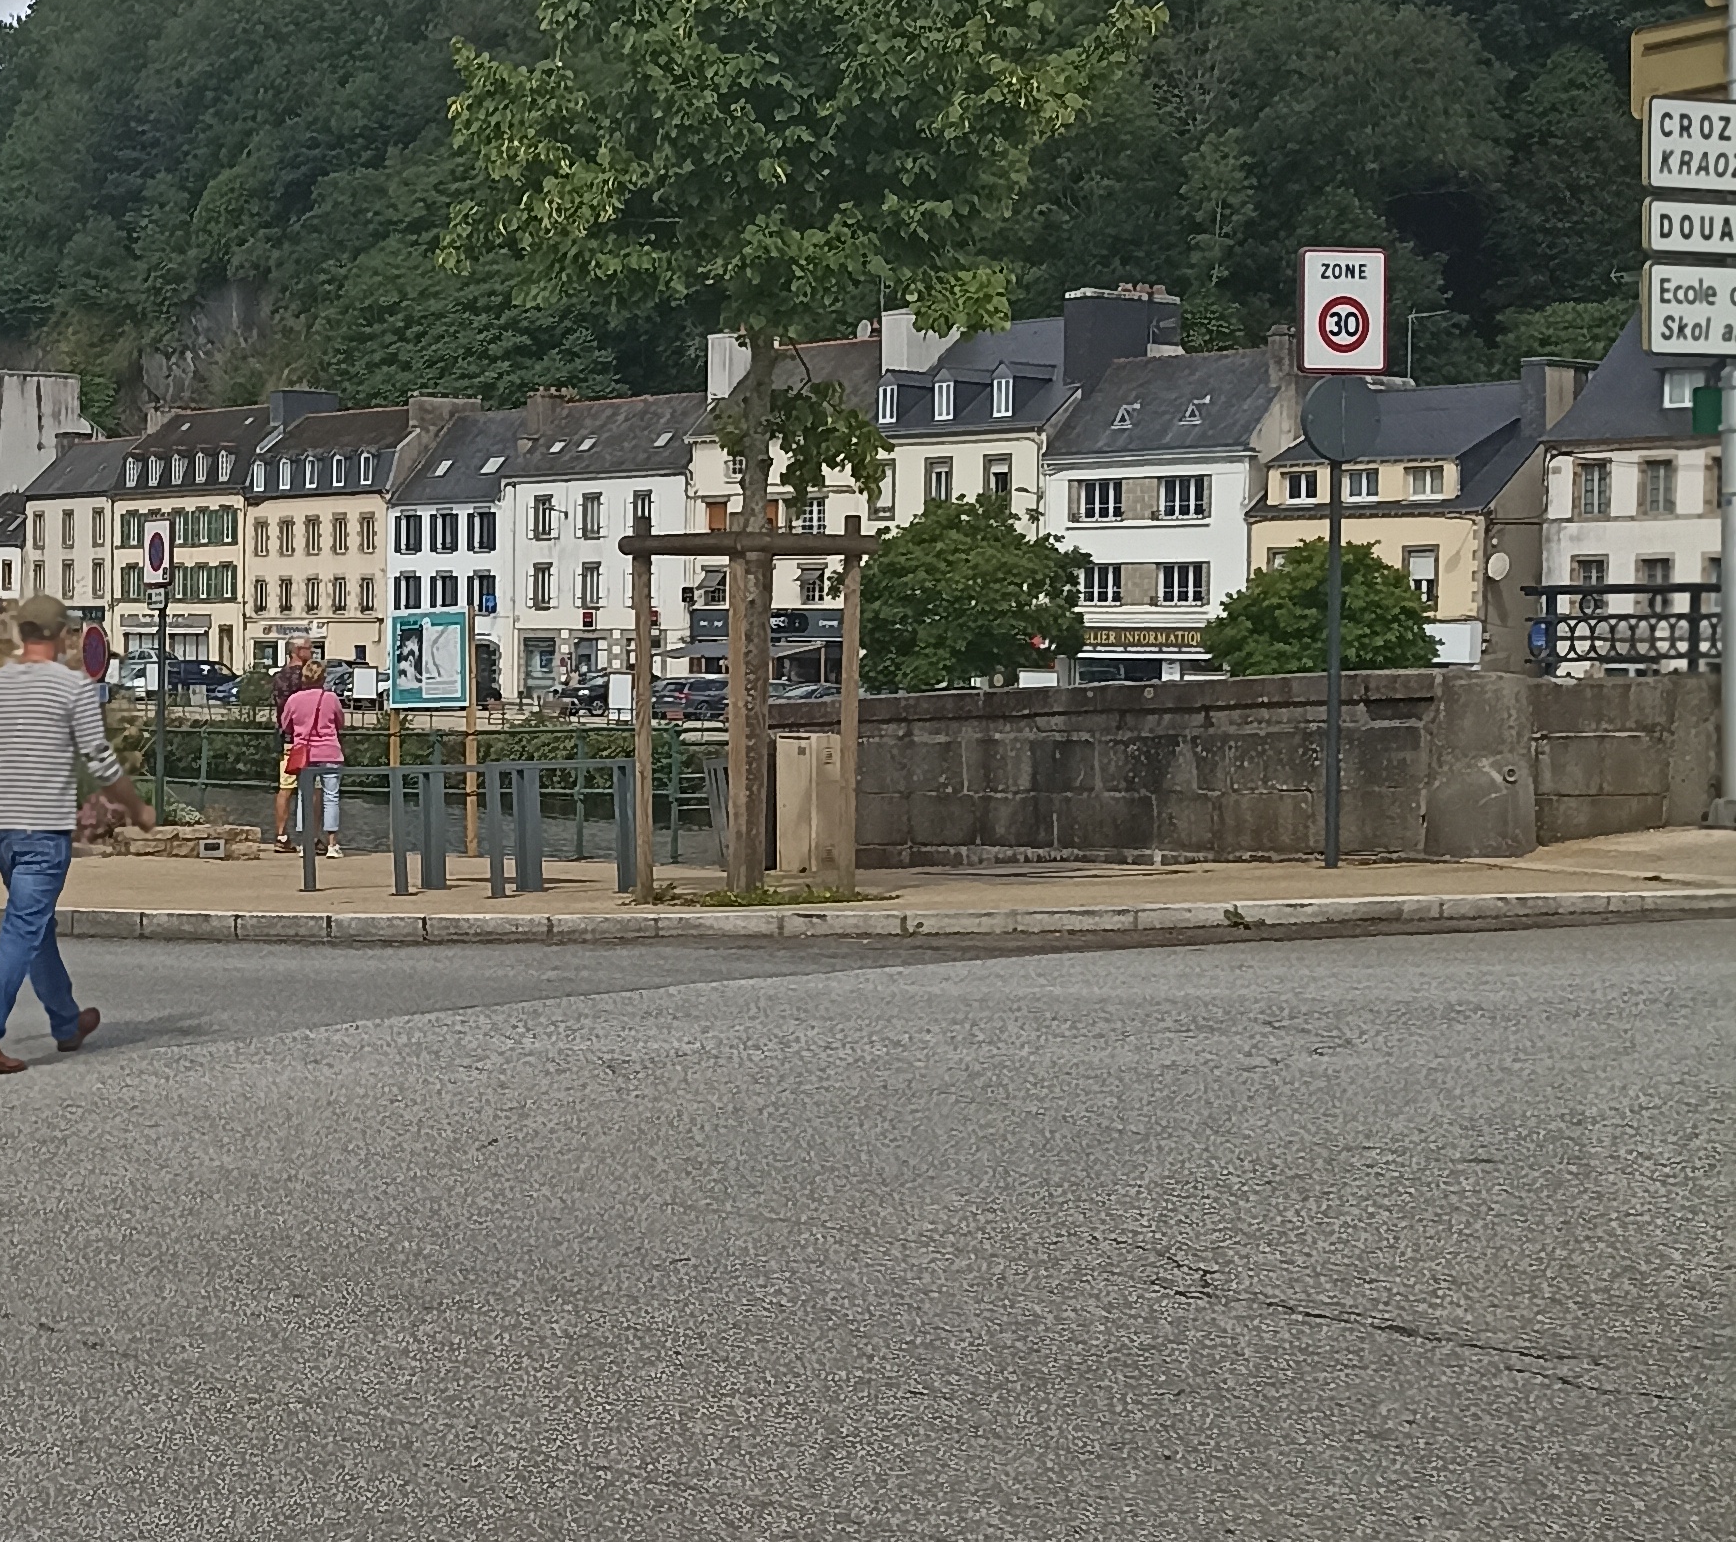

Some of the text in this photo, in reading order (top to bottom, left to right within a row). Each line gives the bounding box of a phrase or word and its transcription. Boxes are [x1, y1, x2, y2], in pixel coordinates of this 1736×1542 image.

[1659, 112, 1732, 141] CROZ
[1659, 213, 1734, 242] DOUA
[1320, 262, 1368, 280] ZONE
[1659, 277, 1717, 305] Ecole
[1328, 311, 1360, 337] 30
[1660, 315, 1736, 342] Skol a
